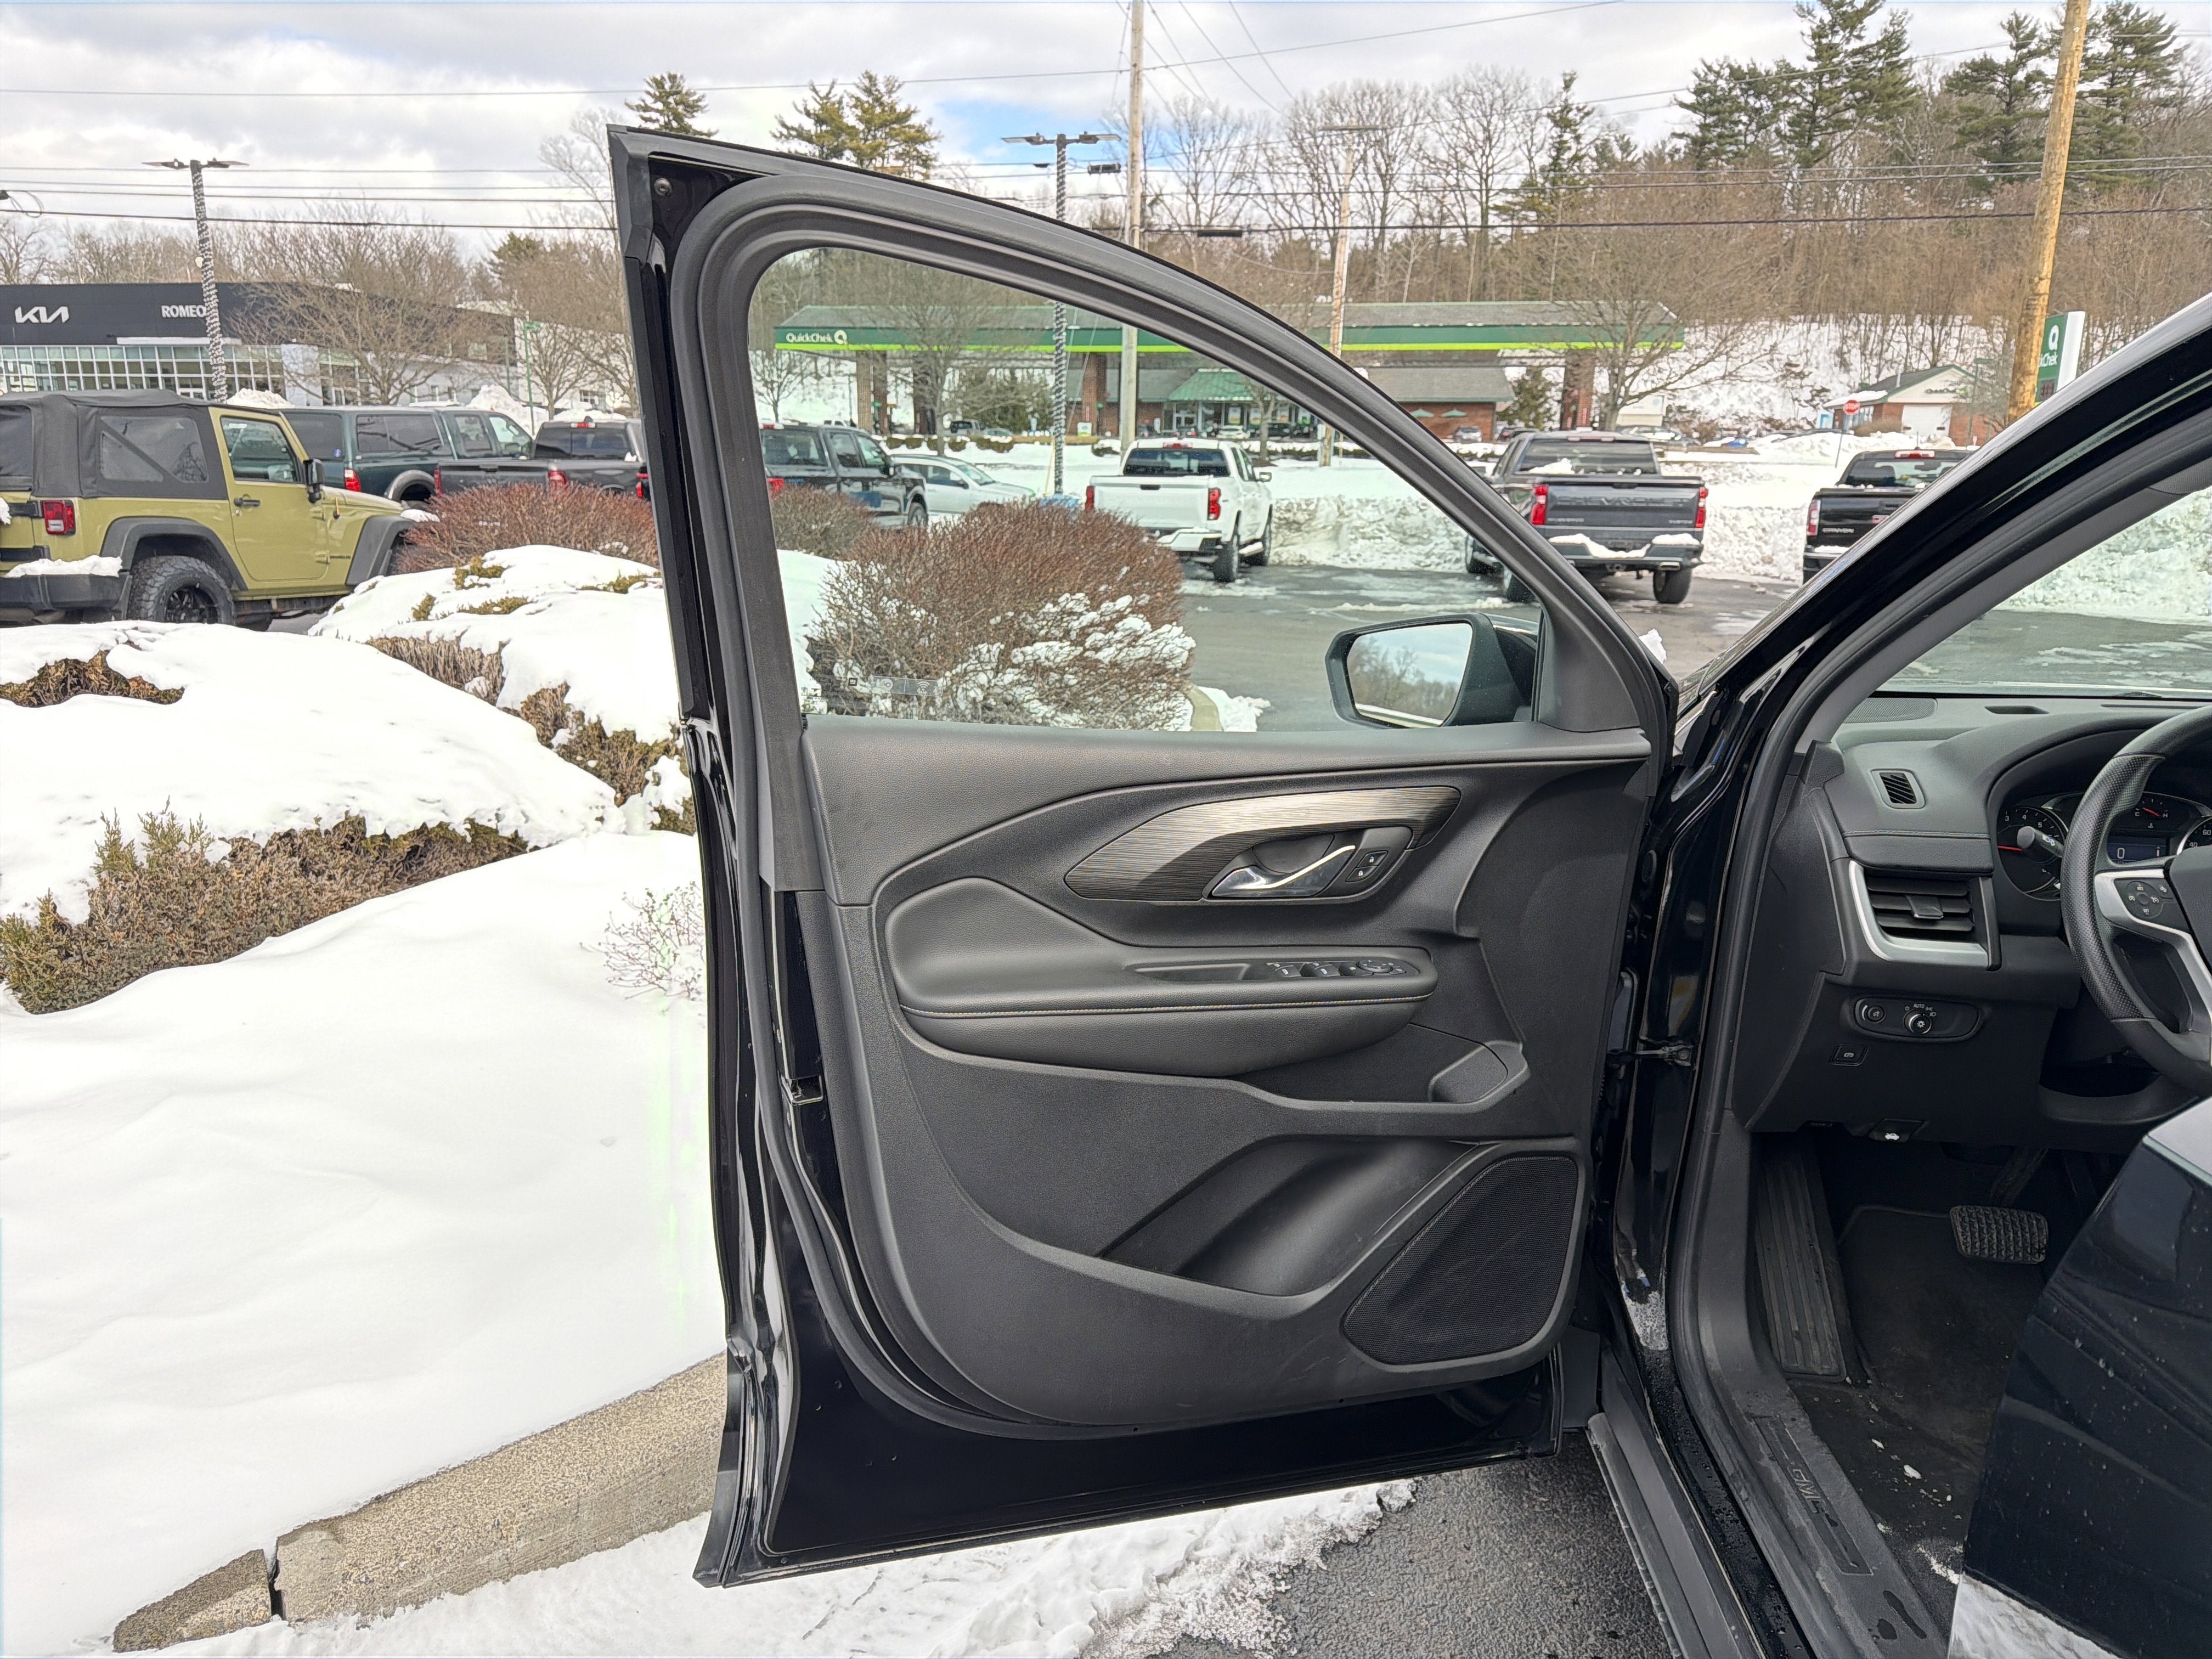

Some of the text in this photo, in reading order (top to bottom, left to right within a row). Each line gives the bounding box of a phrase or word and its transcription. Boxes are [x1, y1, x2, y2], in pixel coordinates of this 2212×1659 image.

[15, 306, 69, 323] KIA
[161, 305, 207, 318] ROMEO
[786, 332, 833, 342] QuickChek
[1556, 495, 1689, 507] CHEVROLET
